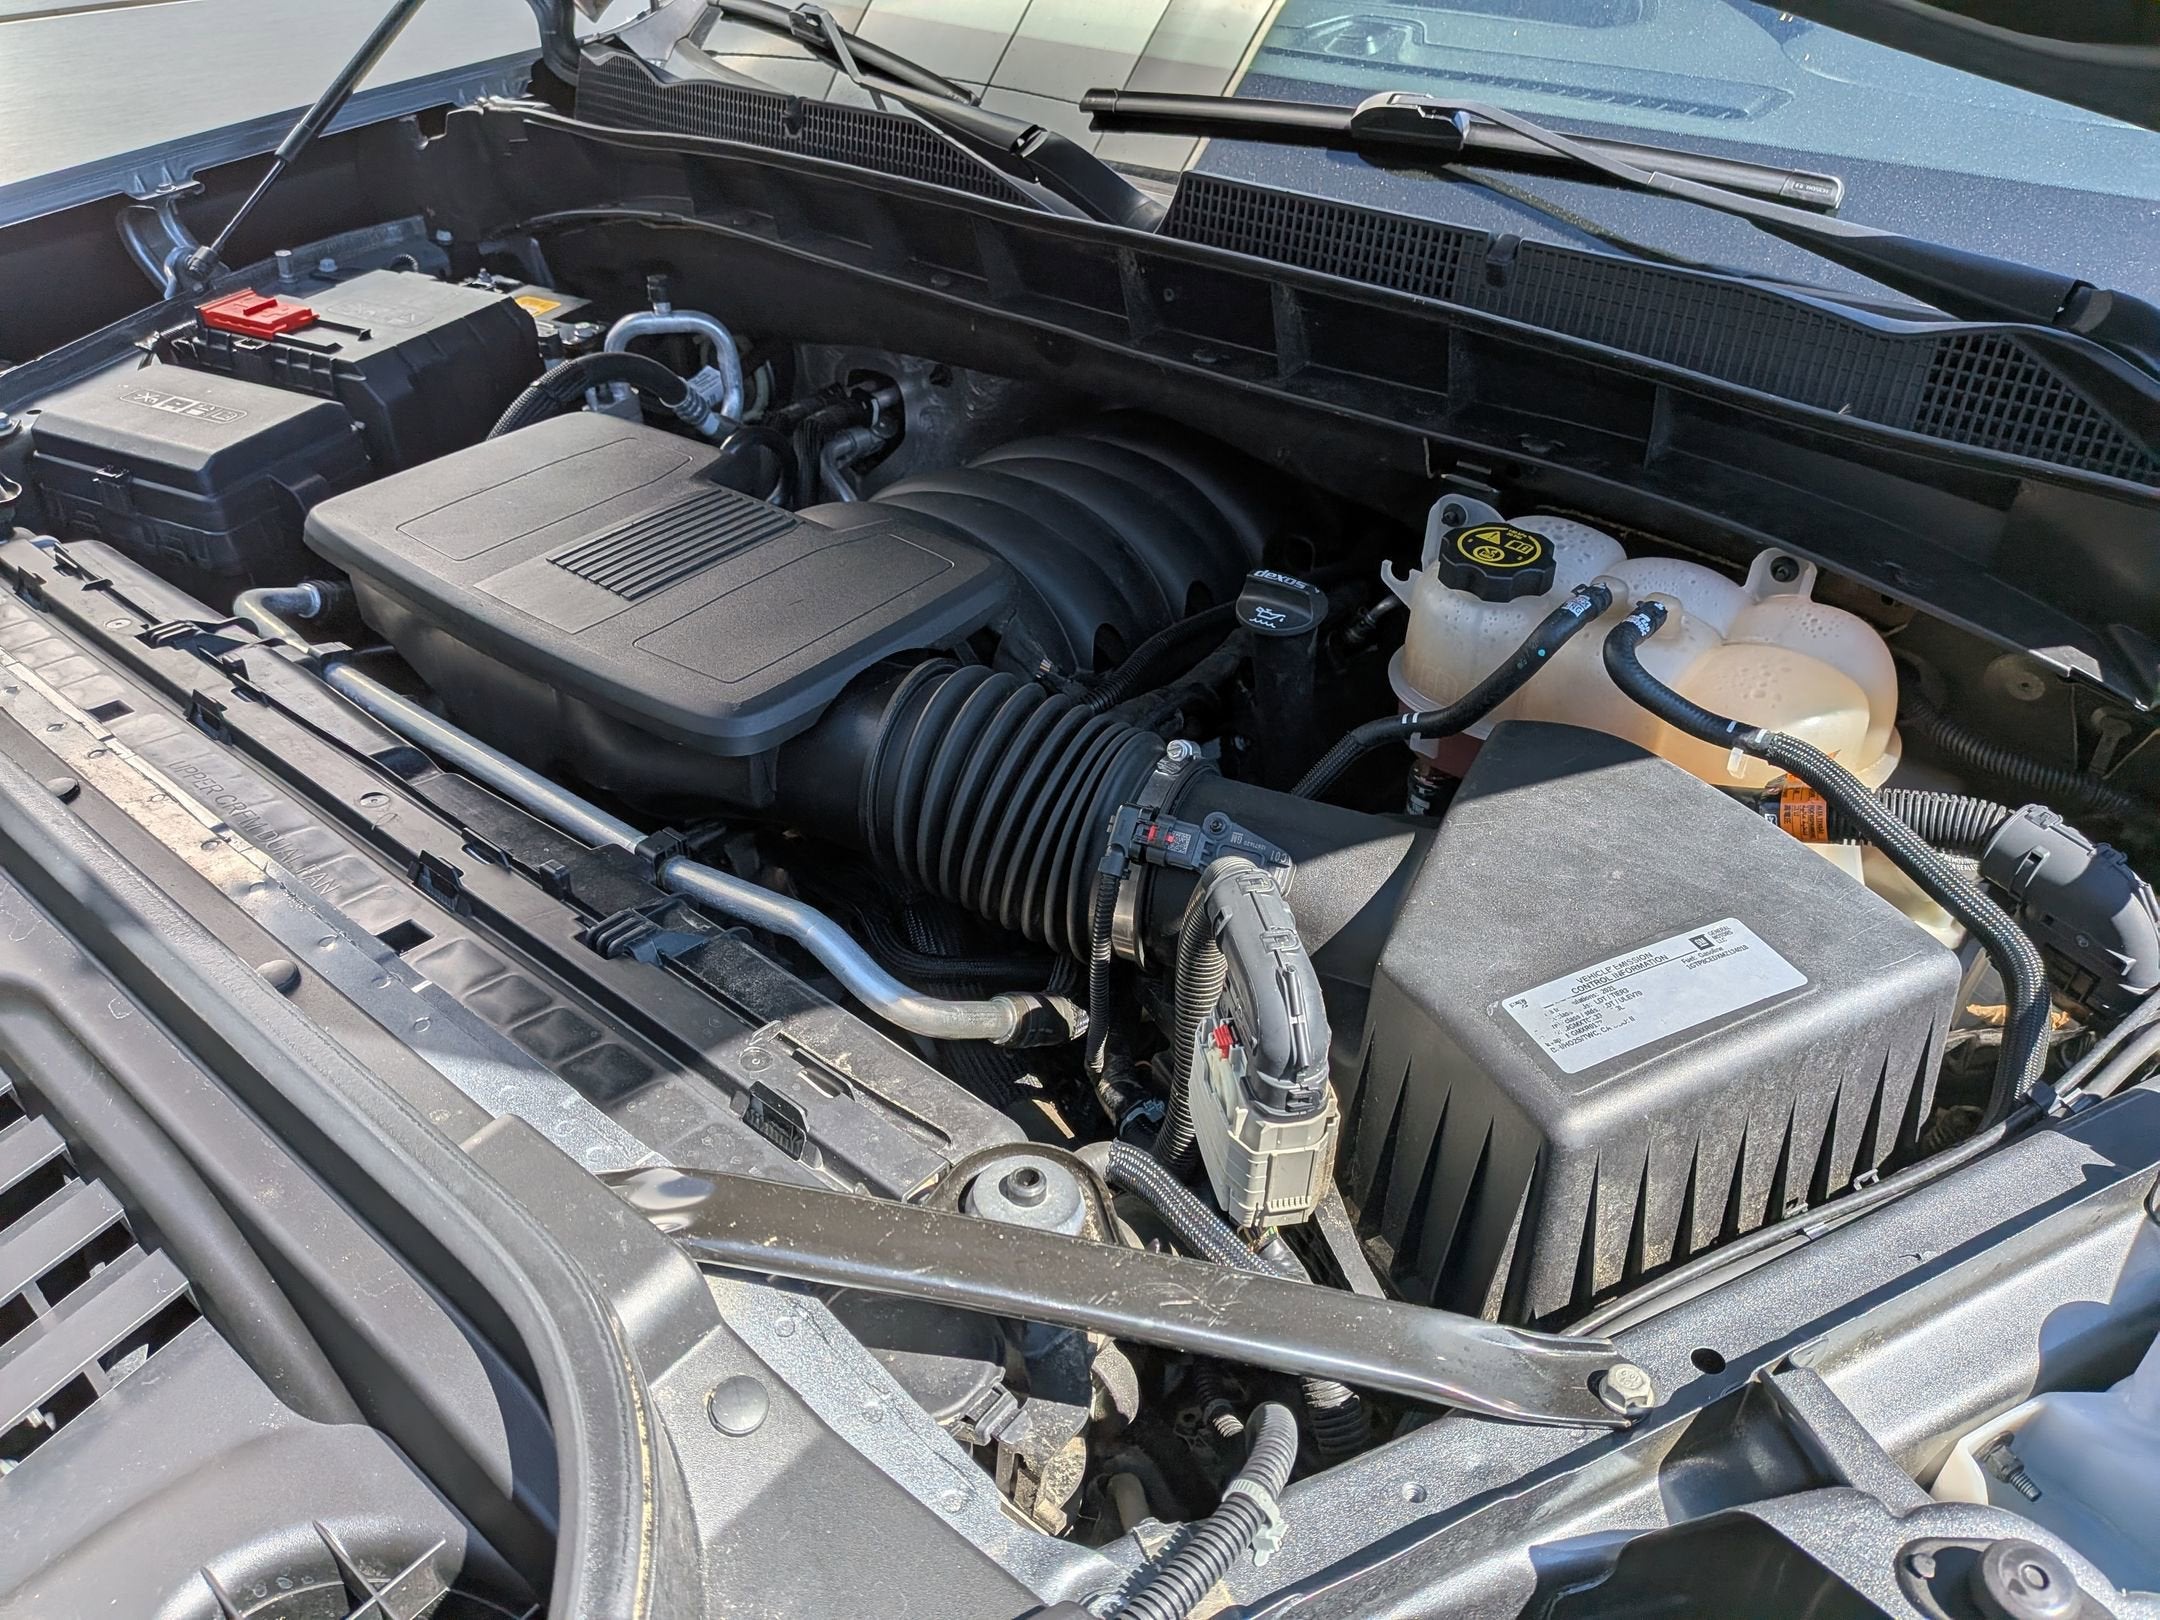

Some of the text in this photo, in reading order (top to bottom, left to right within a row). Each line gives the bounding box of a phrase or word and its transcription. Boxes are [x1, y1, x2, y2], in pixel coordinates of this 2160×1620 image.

[1254, 570, 1310, 590] dexos
[168, 760, 225, 796] UPPER
[256, 830, 305, 869] DUAL
[296, 863, 342, 896] FAN
[1230, 832, 1244, 845] GM
[1612, 951, 1654, 971] EMISSION
[1571, 954, 1669, 994] CONTROL INFORMATION
